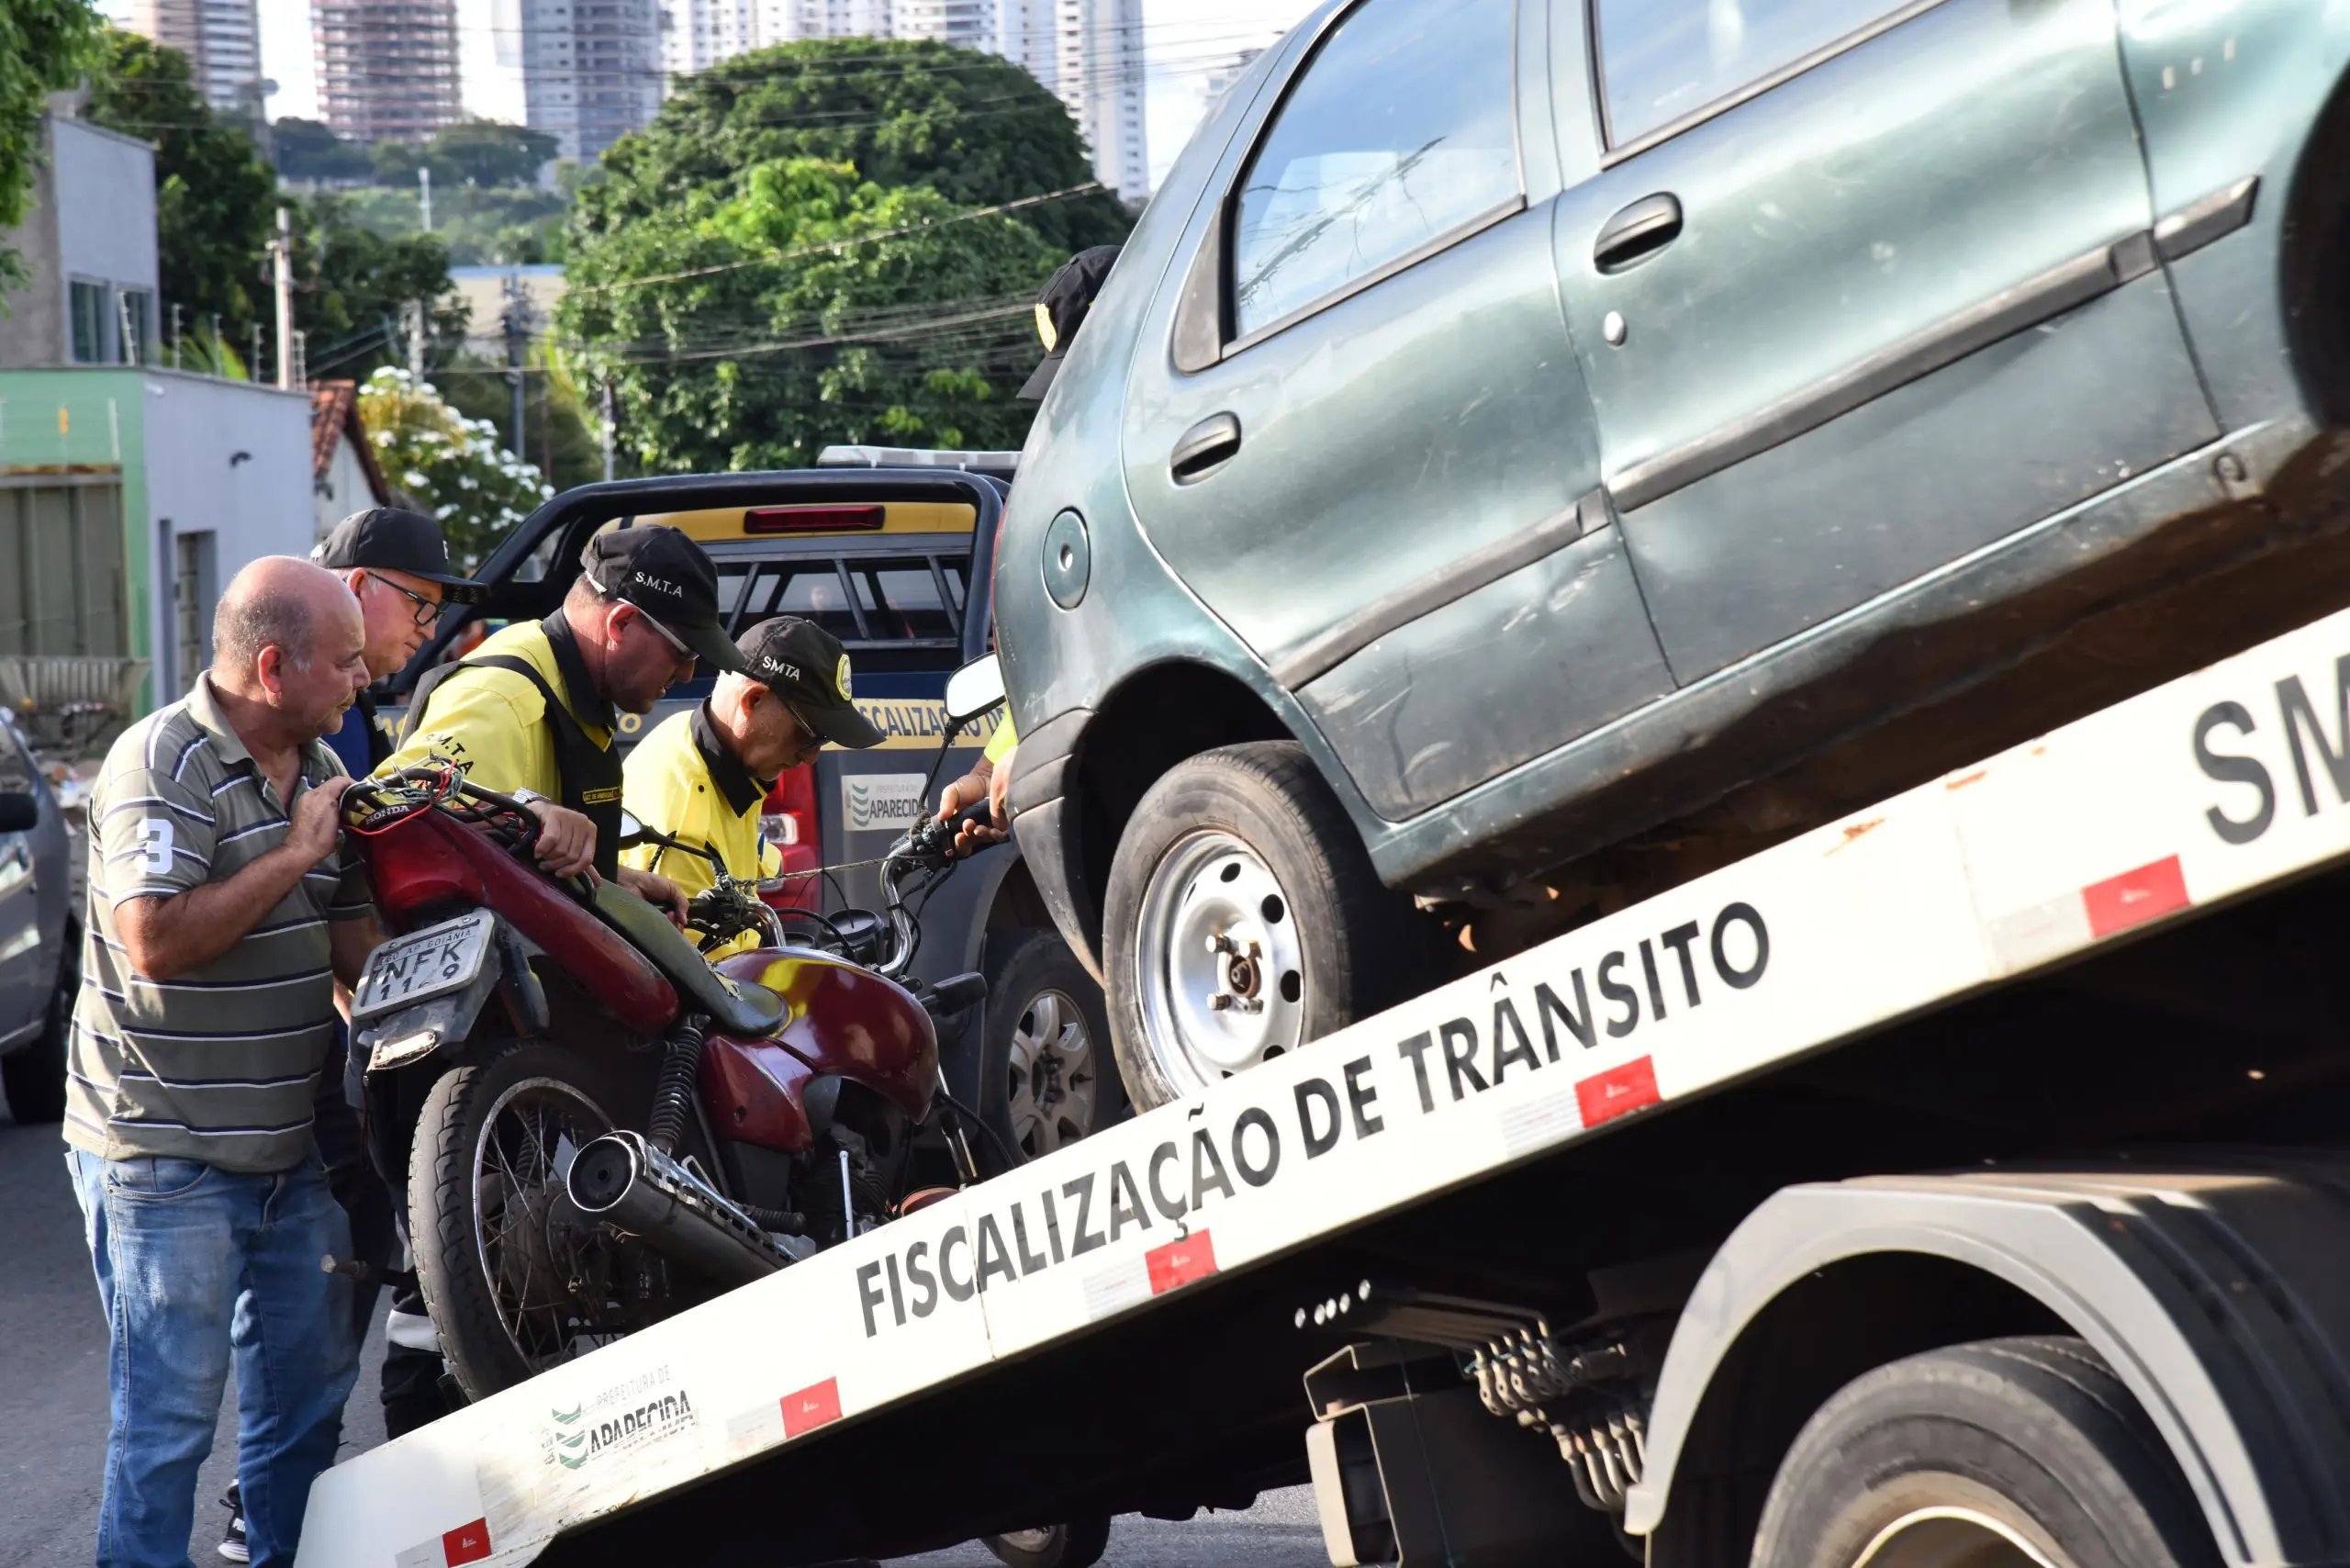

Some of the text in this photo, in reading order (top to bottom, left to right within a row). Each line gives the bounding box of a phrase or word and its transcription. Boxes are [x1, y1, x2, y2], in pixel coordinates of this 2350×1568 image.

[635, 571, 682, 598] S.M.T.A
[762, 655, 800, 681] SMTA
[366, 805, 410, 825] HONDA
[869, 798, 921, 819] APARECID
[134, 817, 174, 875] 3
[380, 964, 460, 1001] 119
[856, 902, 1770, 1338] FISCALIZAÇÃO DE TRÂNSITO
